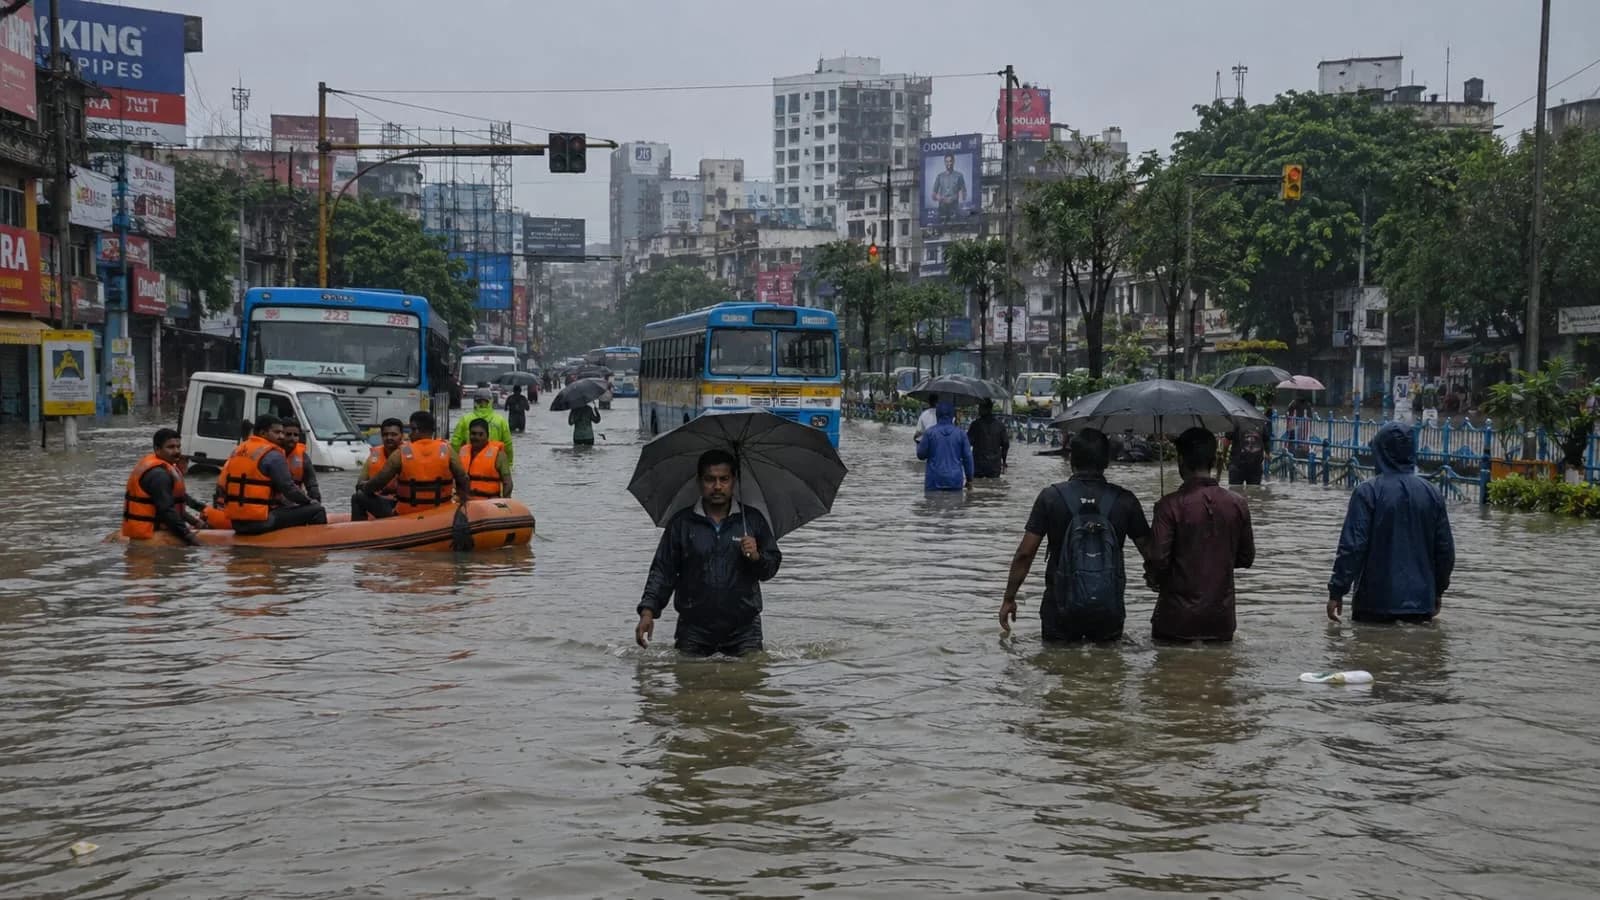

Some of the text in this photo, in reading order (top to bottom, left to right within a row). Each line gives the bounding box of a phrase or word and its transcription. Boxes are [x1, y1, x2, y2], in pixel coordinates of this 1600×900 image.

[58, 18, 143, 57] KING
[78, 57, 143, 79] PIPES
[0, 233, 29, 271] RA
